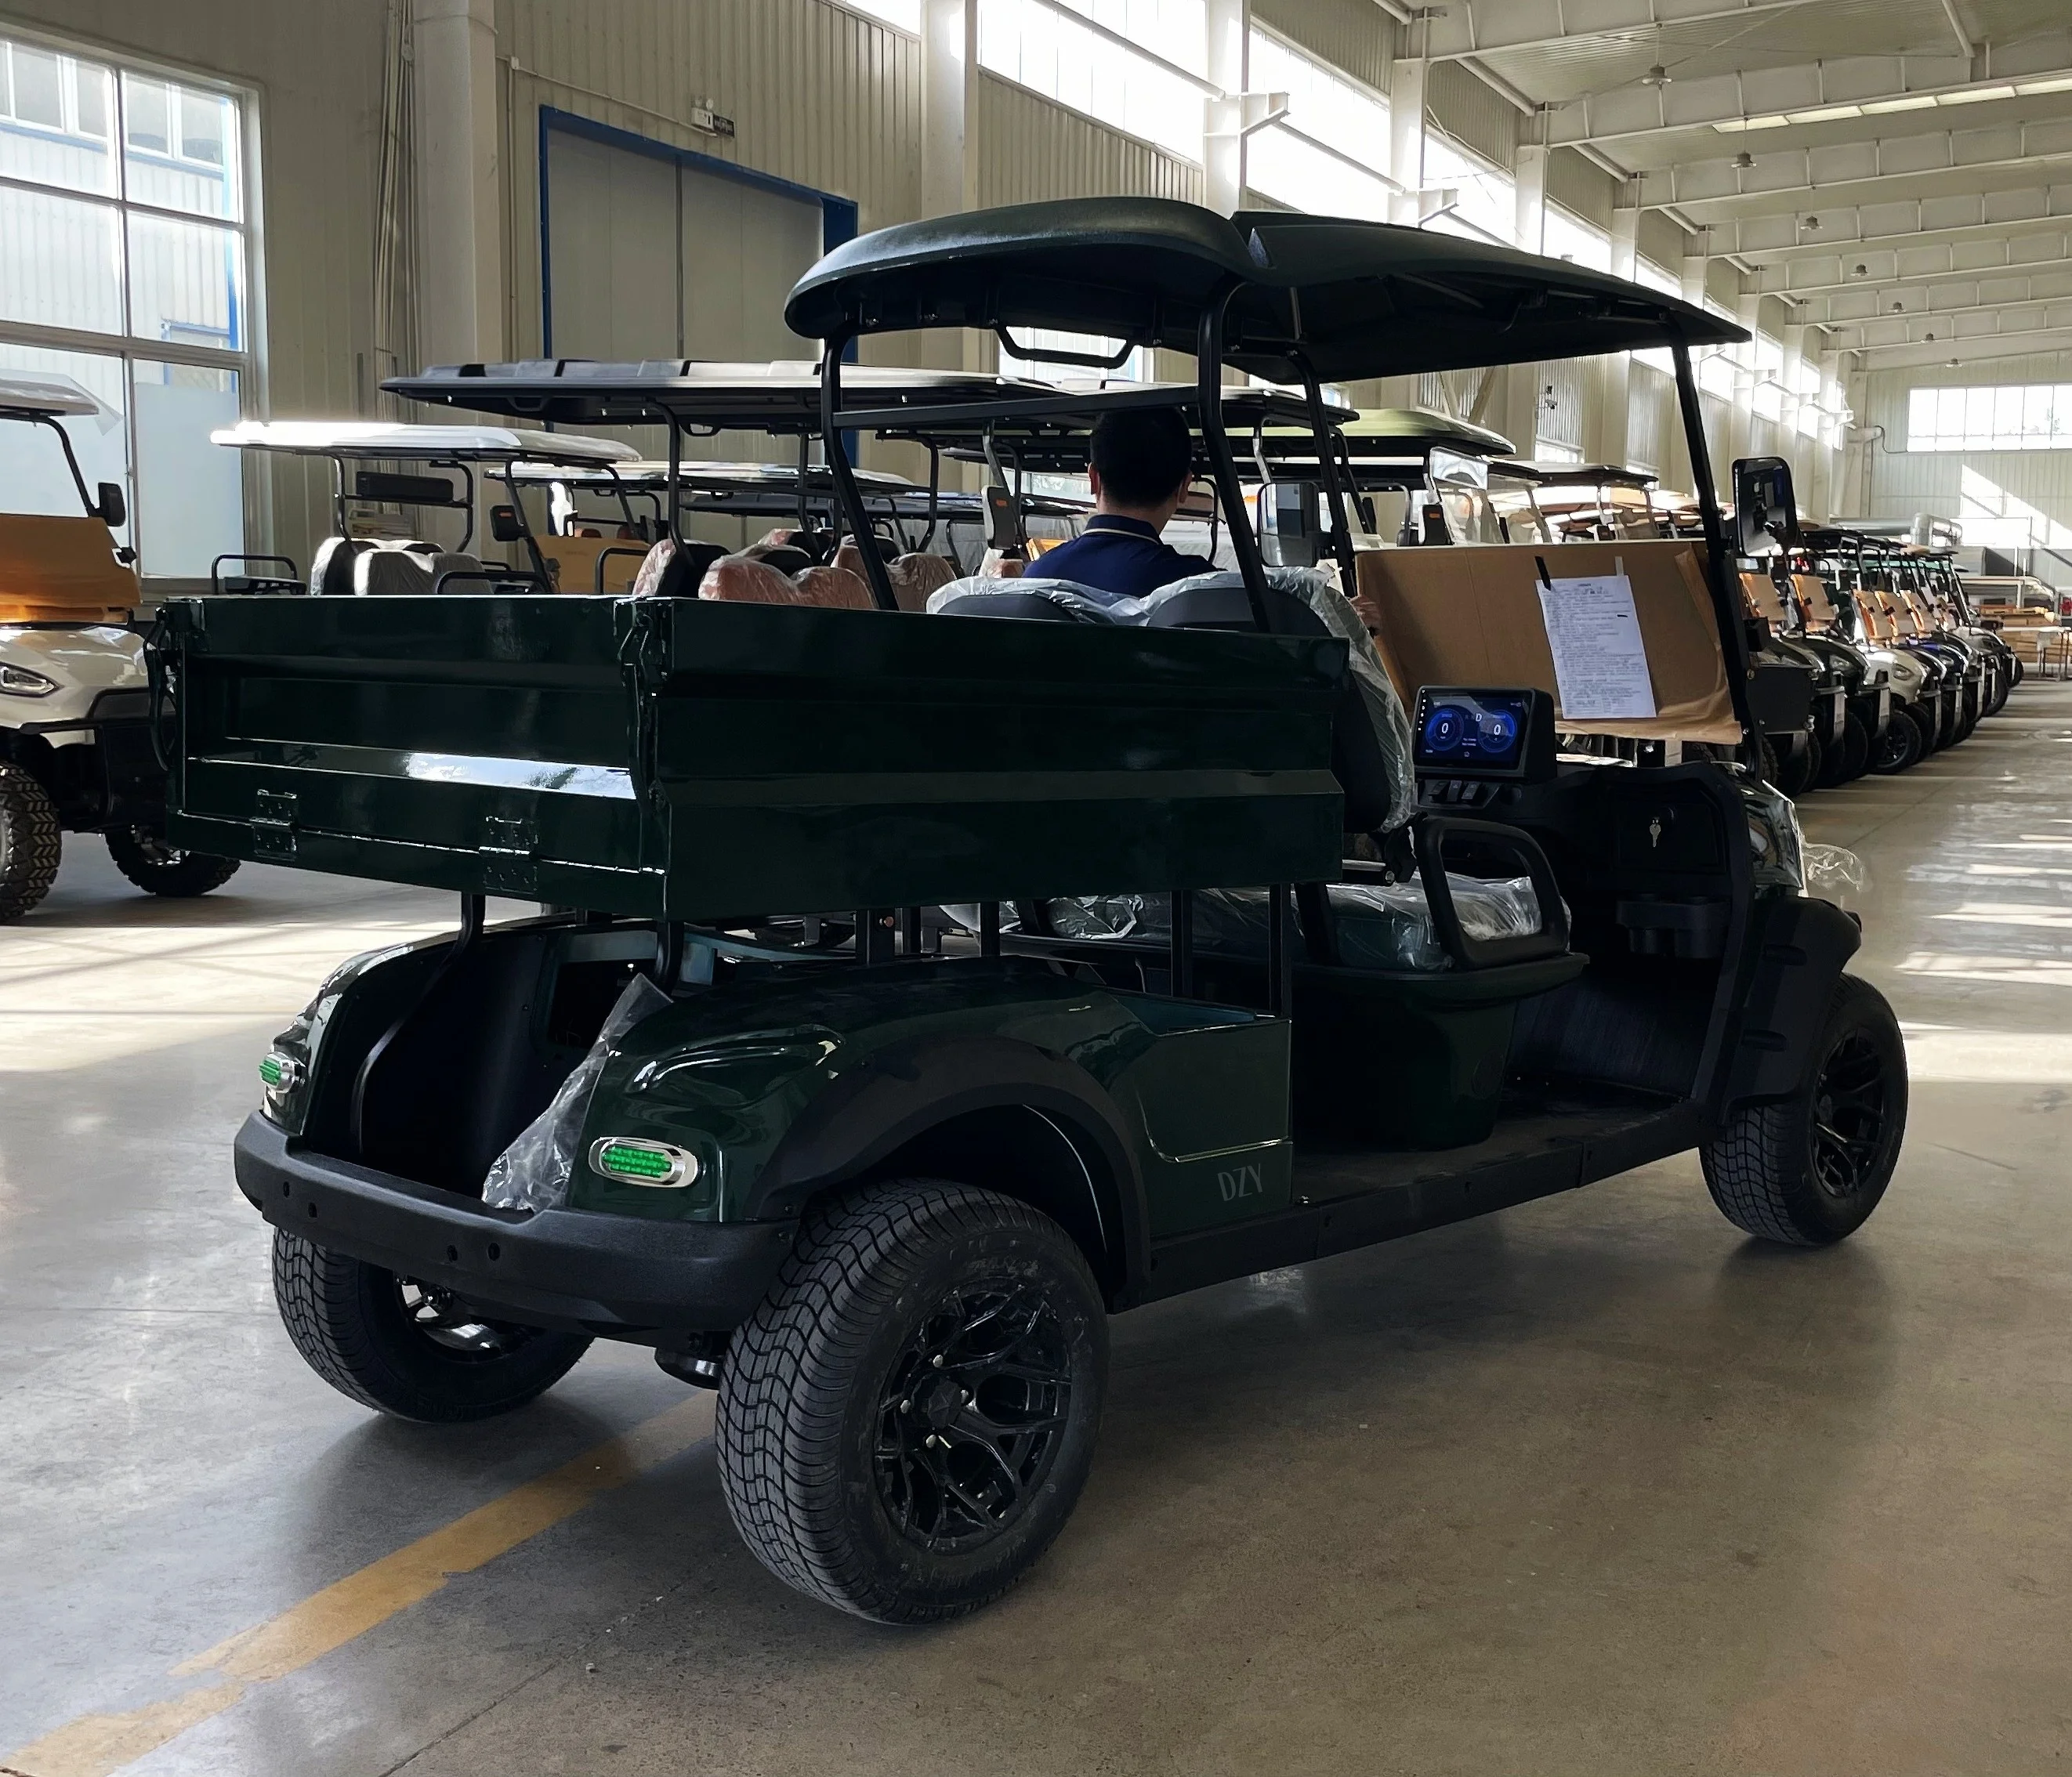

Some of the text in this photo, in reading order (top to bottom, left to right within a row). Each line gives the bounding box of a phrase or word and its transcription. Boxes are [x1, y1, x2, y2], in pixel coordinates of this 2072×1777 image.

[1476, 713, 1482, 722] D
[1442, 722, 1448, 733] 0
[1494, 724, 1501, 735] 0
[1217, 1163, 1262, 1201] DZY
